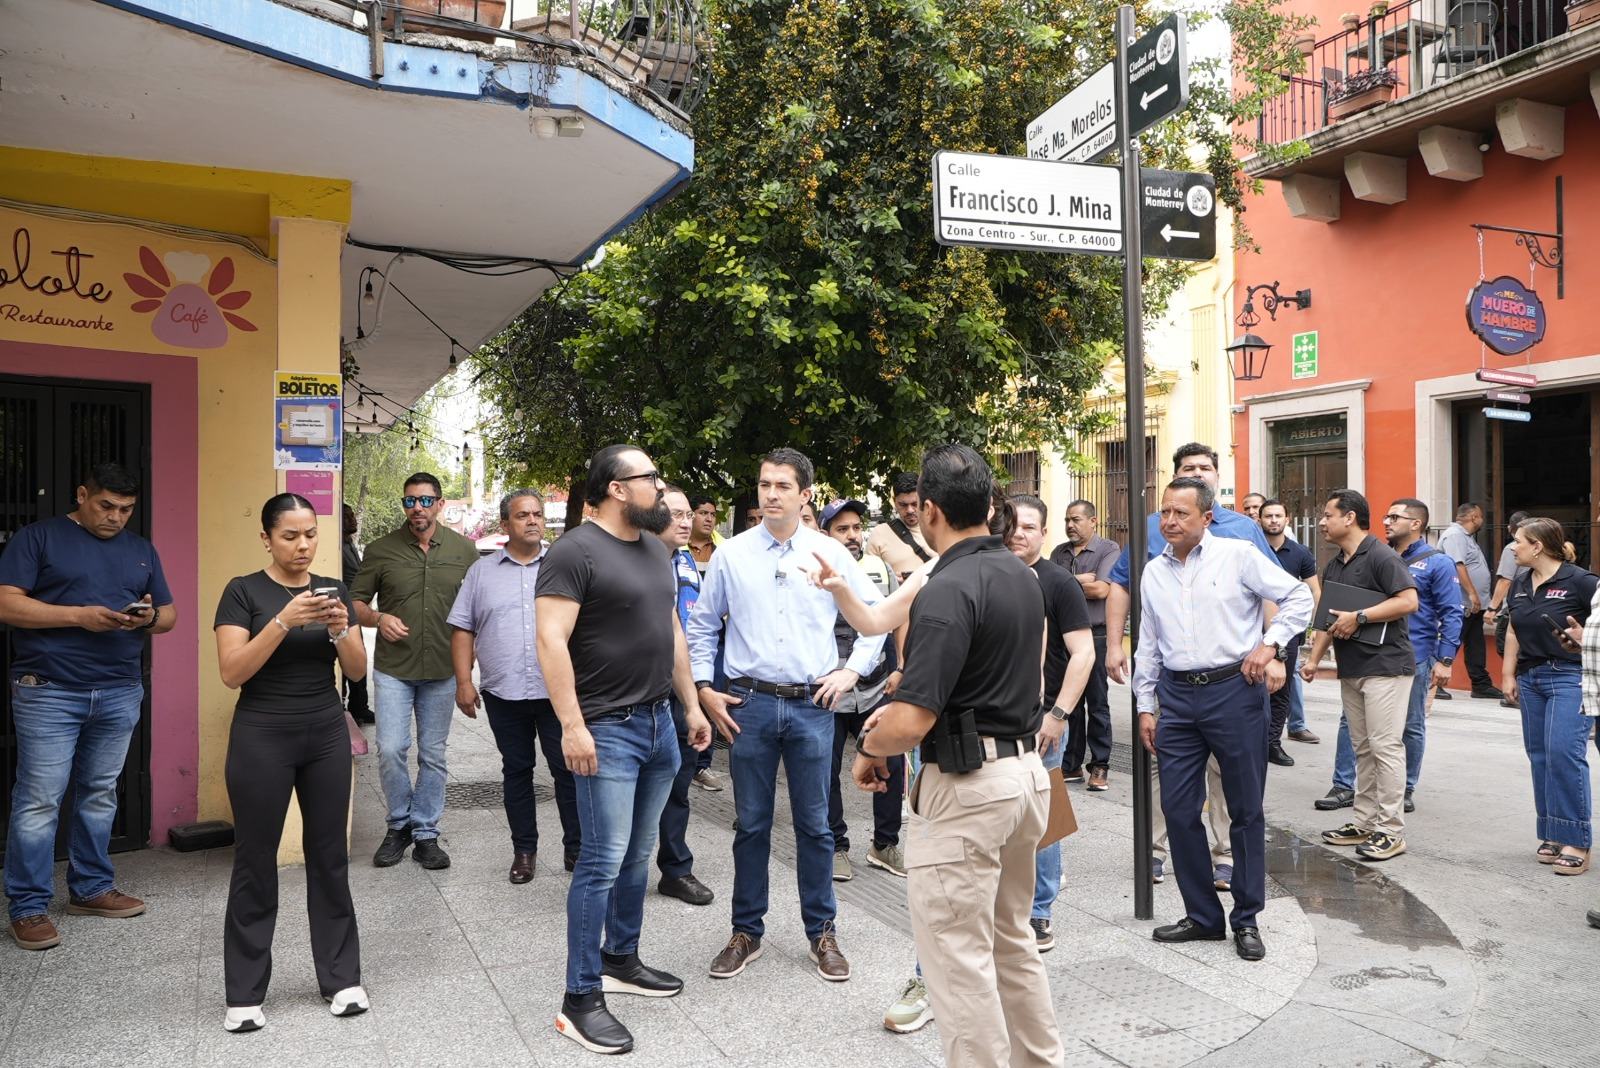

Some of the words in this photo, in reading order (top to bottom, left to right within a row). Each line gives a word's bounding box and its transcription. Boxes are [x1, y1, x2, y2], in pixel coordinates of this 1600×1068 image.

[1130, 52, 1147, 73] Ciudad
[1148, 48, 1156, 60] de
[1129, 60, 1156, 84] Monterrey
[1028, 124, 1043, 141] Calle
[1052, 130, 1068, 153] Ma.
[1071, 98, 1112, 140] Morelos
[1093, 130, 1113, 151] 64000
[948, 163, 981, 177] Calle
[949, 185, 1039, 215] Francisco
[1048, 194, 1061, 217] J.
[1069, 195, 1112, 221] Mina
[1145, 186, 1171, 198] Ciudad
[1173, 187, 1184, 199] de
[1145, 196, 1185, 212] Monterrey
[946, 224, 974, 237] Zona
[978, 226, 1016, 240] Centro
[1058, 233, 1077, 245] C.P.
[1081, 234, 1116, 247] 64000
[1503, 290, 1516, 299] ME
[1481, 295, 1527, 316] MUERO
[0, 303, 114, 332] Restaurante
[170, 302, 209, 334] Café
[1480, 310, 1537, 333] HAMBRE
[279, 381, 338, 396] BOLETOS
[1290, 426, 1343, 440] ABIERTO
